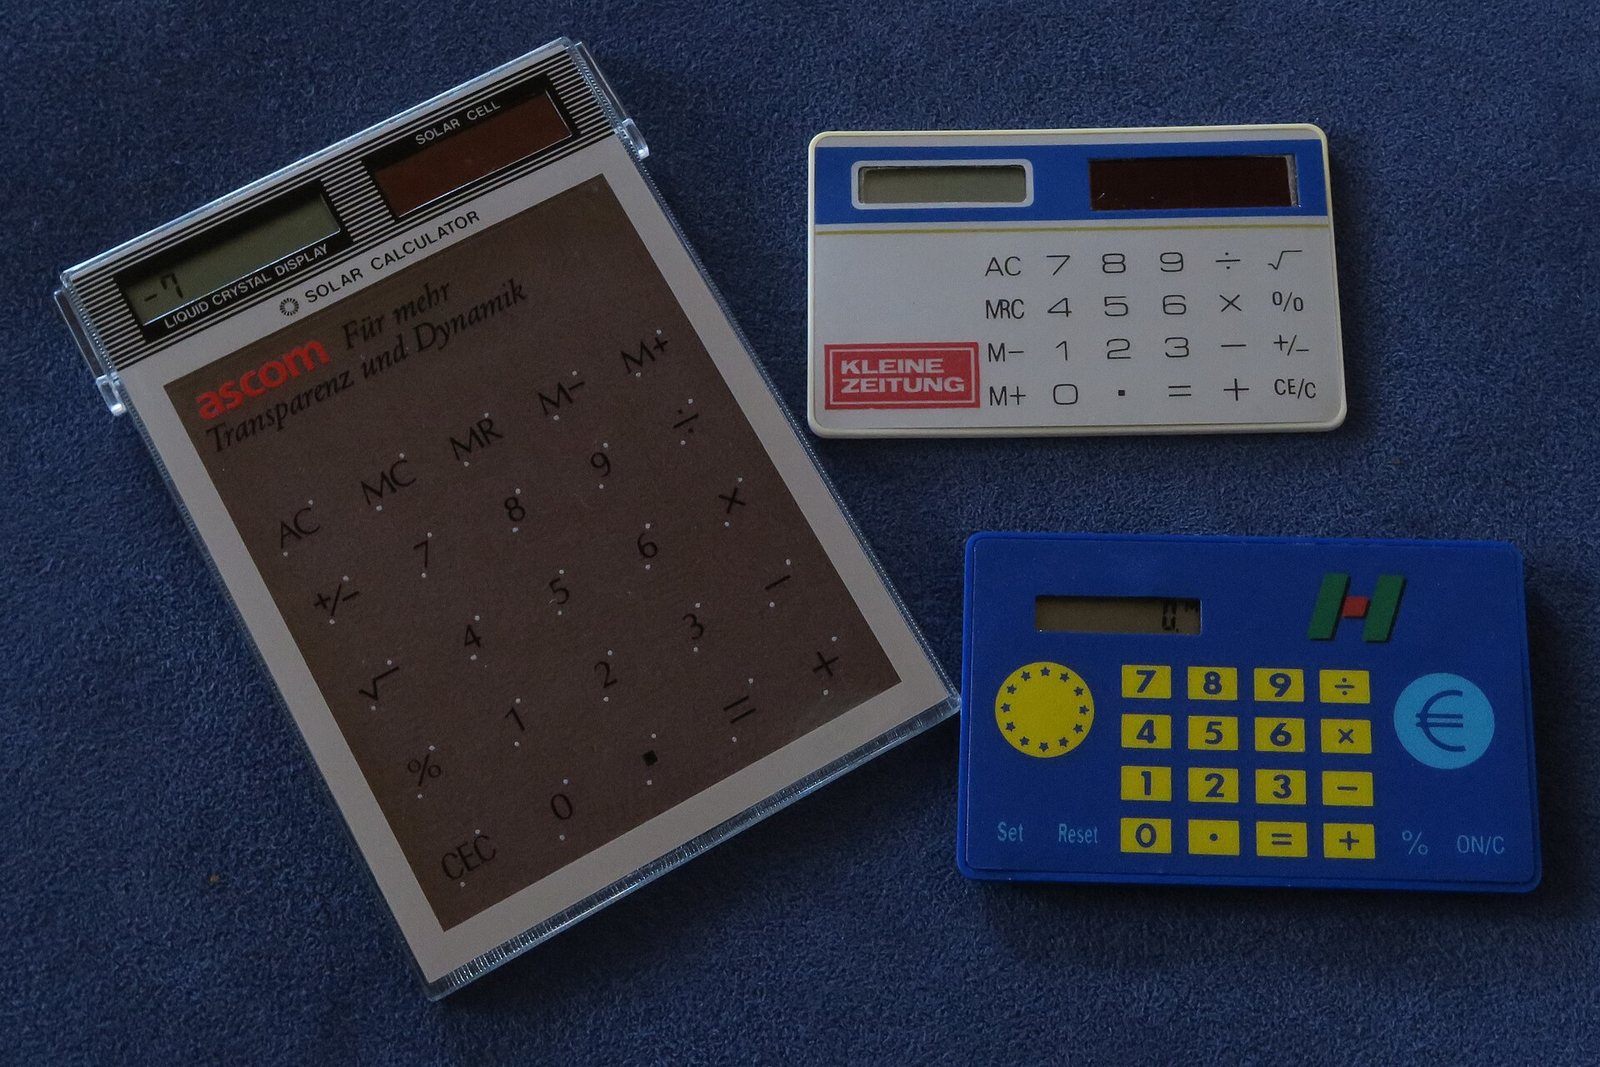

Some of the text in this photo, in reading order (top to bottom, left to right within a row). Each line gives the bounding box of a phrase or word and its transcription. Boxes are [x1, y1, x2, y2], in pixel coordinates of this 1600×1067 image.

[414, 99, 501, 145] SOLAR CELL
[305, 210, 480, 303] SOLAR CALCULATOR
[984, 255, 1022, 277] AC
[1045, 254, 1071, 276] 7
[1101, 252, 1127, 274] 8
[1159, 251, 1185, 273] 9
[164, 243, 329, 329] LIQUID CRYSTAL DISPLAY
[341, 280, 452, 351] Für mehr
[985, 298, 1025, 320] MRC
[1047, 297, 1073, 318] 4
[1103, 295, 1129, 318] 5
[1162, 294, 1187, 316] 6
[1271, 290, 1304, 313] %
[1055, 340, 1069, 362] 1
[1106, 338, 1132, 360] 2
[1164, 336, 1190, 359] 3
[195, 339, 331, 421] ascom
[206, 278, 528, 452] Transparenz und Dynamik
[841, 359, 944, 375] KLEINE
[841, 377, 965, 394] ZEITUNG
[1052, 383, 1079, 406] 0
[1273, 378, 1317, 400] CE/C
[279, 506, 321, 548] AC
[360, 459, 417, 506] MC
[449, 418, 504, 461] MR
[412, 539, 429, 569] 7
[503, 496, 527, 523] 8
[589, 451, 612, 478] 9
[463, 623, 482, 649] 4
[548, 577, 570, 605] 5
[636, 532, 659, 559] 6
[1136, 669, 1157, 694] 7
[1203, 671, 1223, 695] 8
[1269, 672, 1292, 698] 9
[406, 753, 443, 787] %
[504, 706, 526, 733] 1
[593, 660, 618, 689] 2
[682, 613, 705, 641] 3
[1136, 719, 1157, 744] 4
[1204, 720, 1224, 745] 5
[1269, 722, 1292, 747] 6
[1140, 770, 1152, 797] 1
[1204, 772, 1225, 799] 2
[1272, 773, 1292, 800] 3
[440, 834, 497, 881] CEC
[550, 793, 574, 821] 0
[997, 821, 1098, 844] Set Reset
[1135, 824, 1157, 849] 0
[1401, 829, 1505, 856] % ON/C
